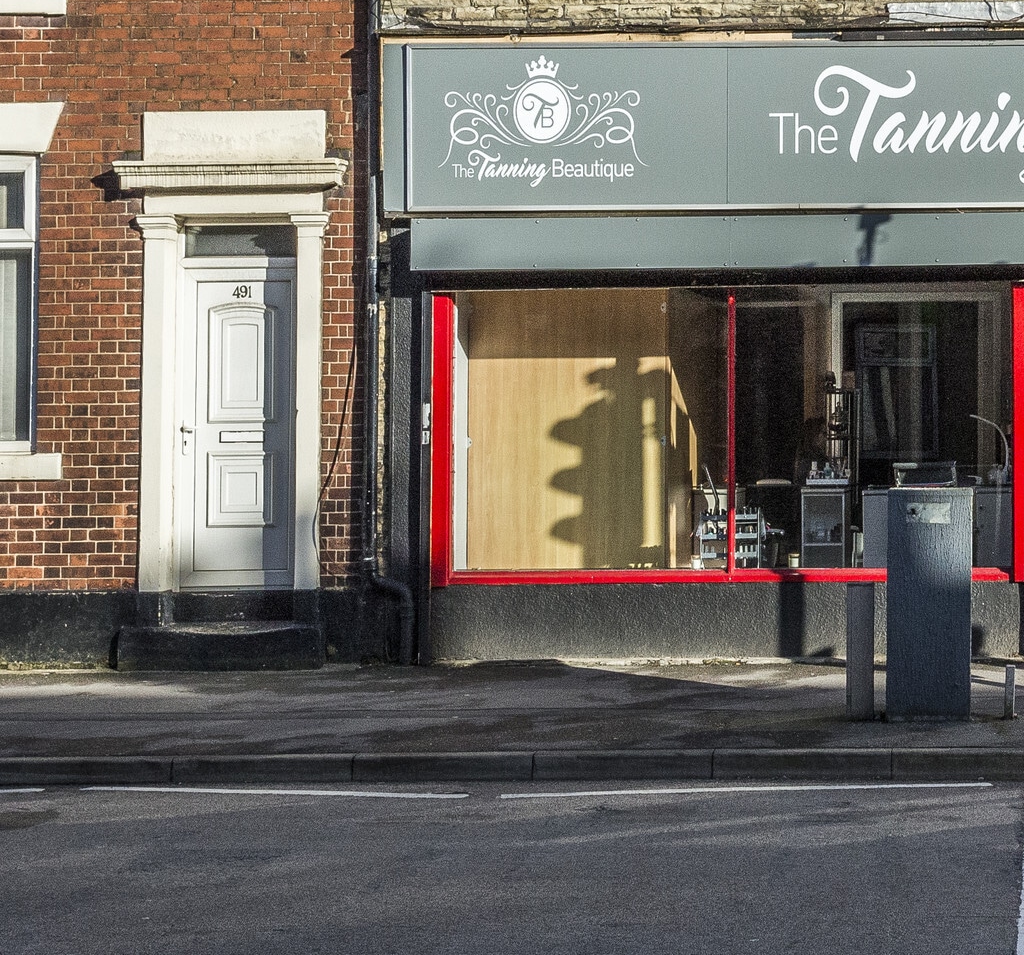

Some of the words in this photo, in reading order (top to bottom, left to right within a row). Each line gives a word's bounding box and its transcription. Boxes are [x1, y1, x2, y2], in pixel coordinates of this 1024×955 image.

[769, 111, 838, 155] The
[452, 163, 475, 178] The
[468, 149, 552, 188] Tanning
[552, 158, 635, 183] Beautique
[232, 285, 252, 299] 491
